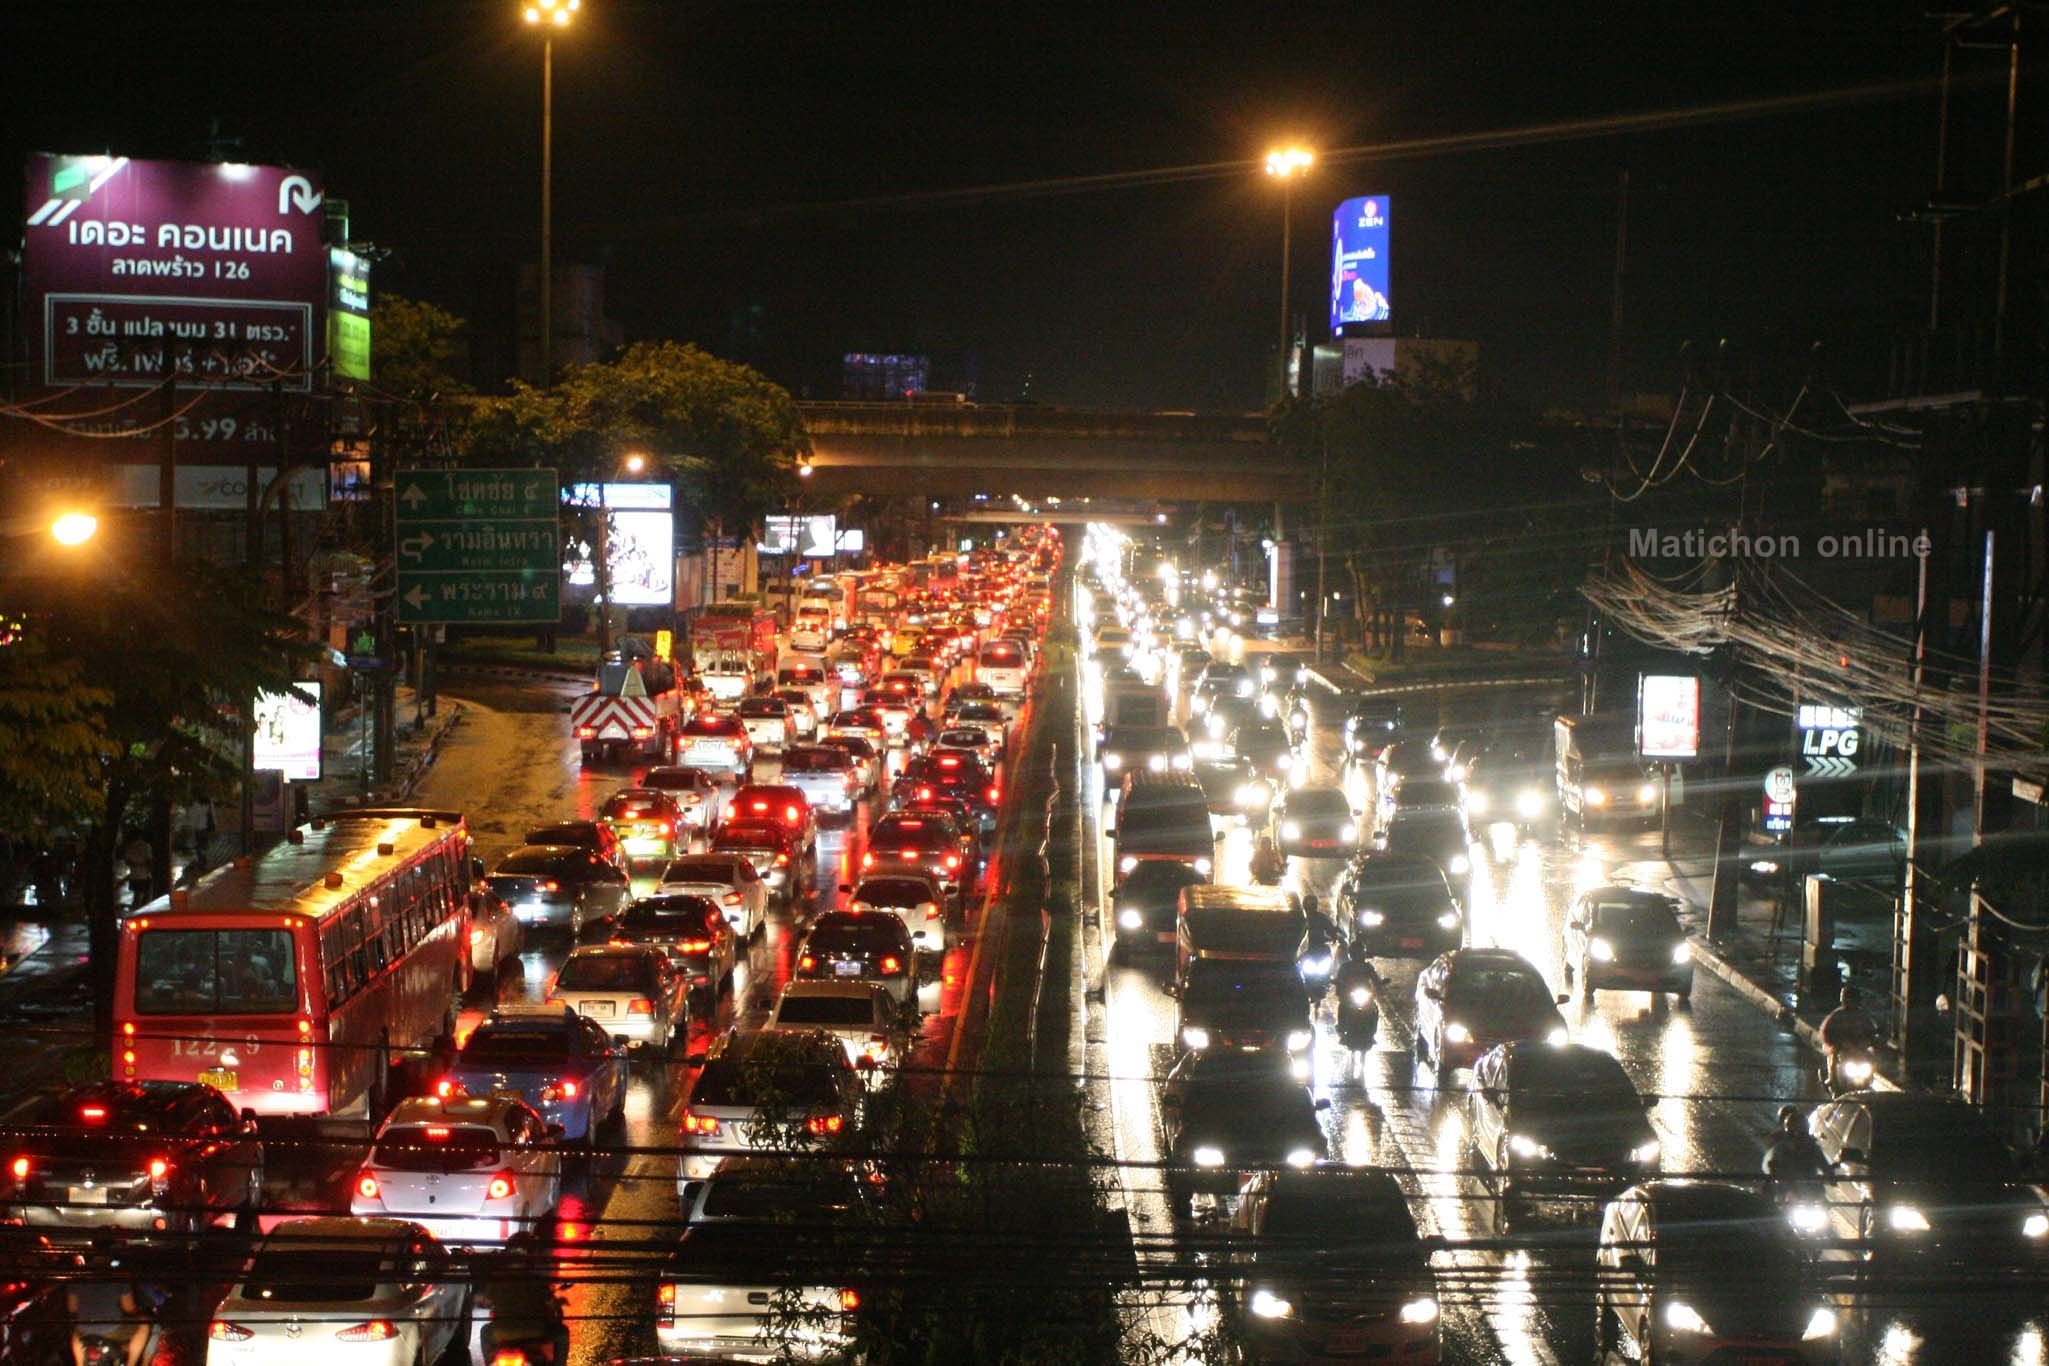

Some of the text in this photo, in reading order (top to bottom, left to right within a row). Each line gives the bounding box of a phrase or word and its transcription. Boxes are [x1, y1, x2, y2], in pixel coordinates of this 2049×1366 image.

[1358, 216, 1384, 228] ZEN
[69, 219, 293, 254] เดอะ คอนเนค
[112, 254, 251, 280] ลาดพร้าว 126
[66, 315, 79, 335] 3
[86, 306, 117, 336] ชั้น
[213, 320, 237, 340] 31
[438, 526, 554, 551] รามอินทรา
[440, 582, 527, 601] พระราม
[1803, 729, 1859, 756] LPG
[171, 1034, 217, 1057] 122
